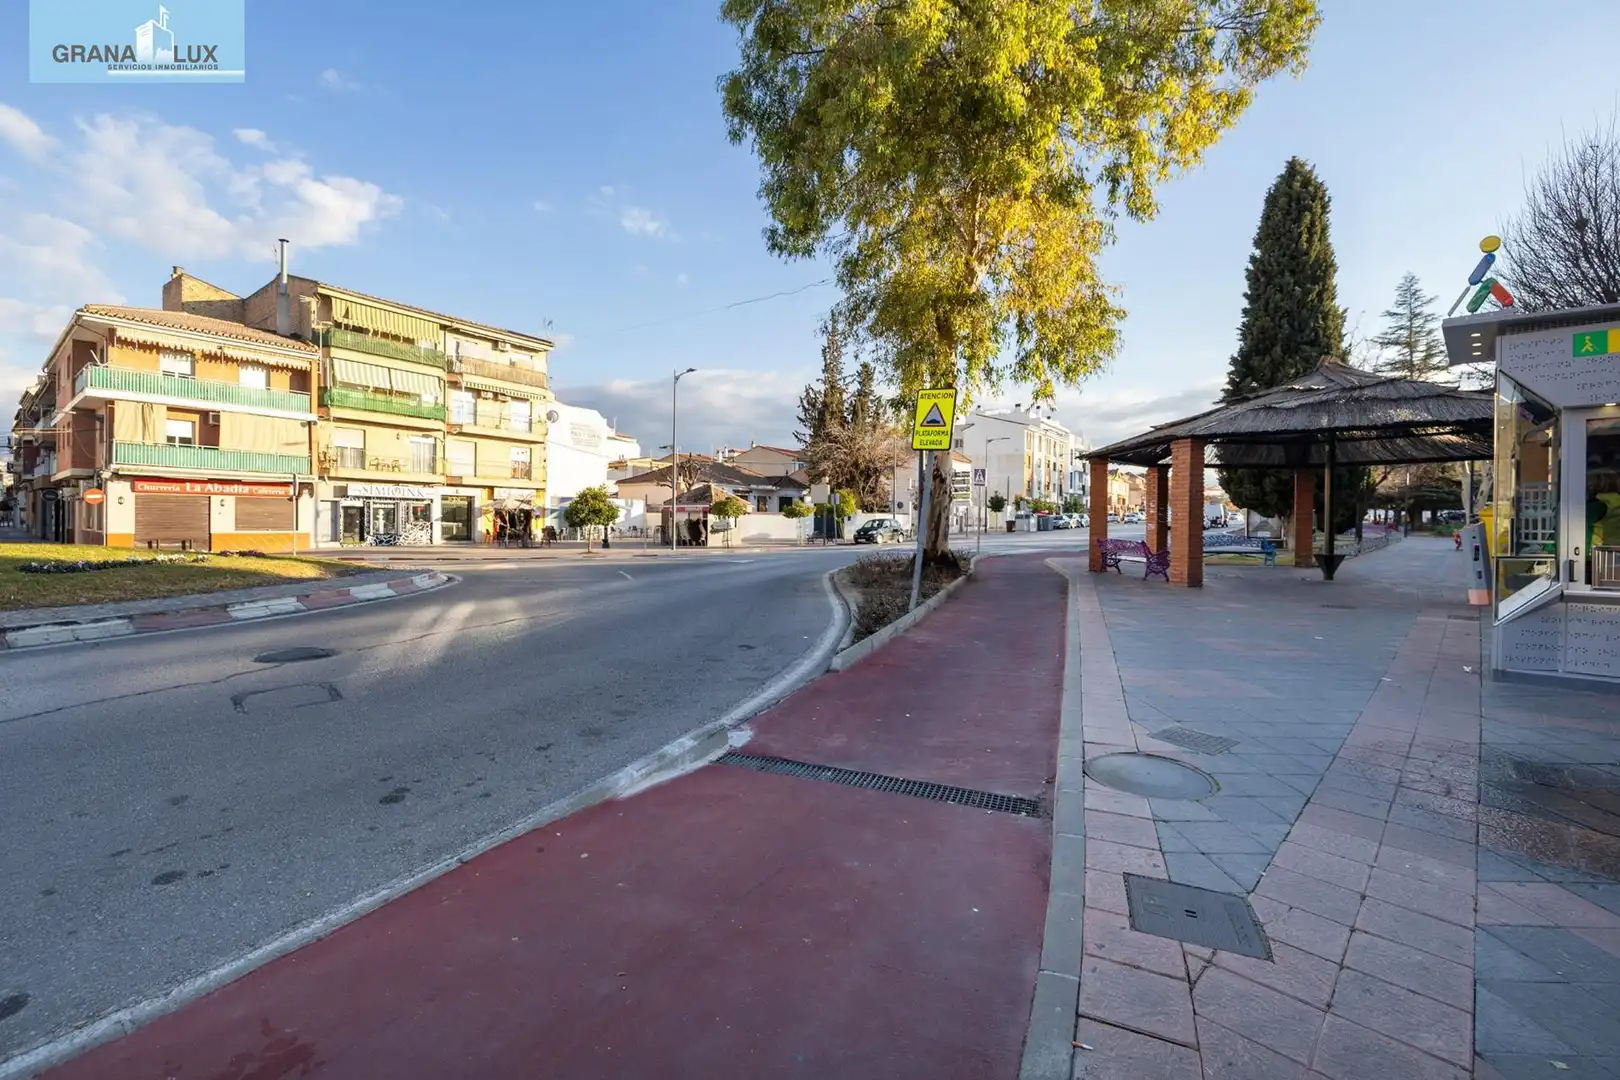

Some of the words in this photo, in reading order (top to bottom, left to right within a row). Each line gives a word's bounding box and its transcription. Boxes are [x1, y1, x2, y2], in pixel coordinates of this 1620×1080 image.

[919, 391, 954, 400] ATENCION
[915, 429, 949, 437] PLATAFORMA
[185, 482, 201, 492] La
